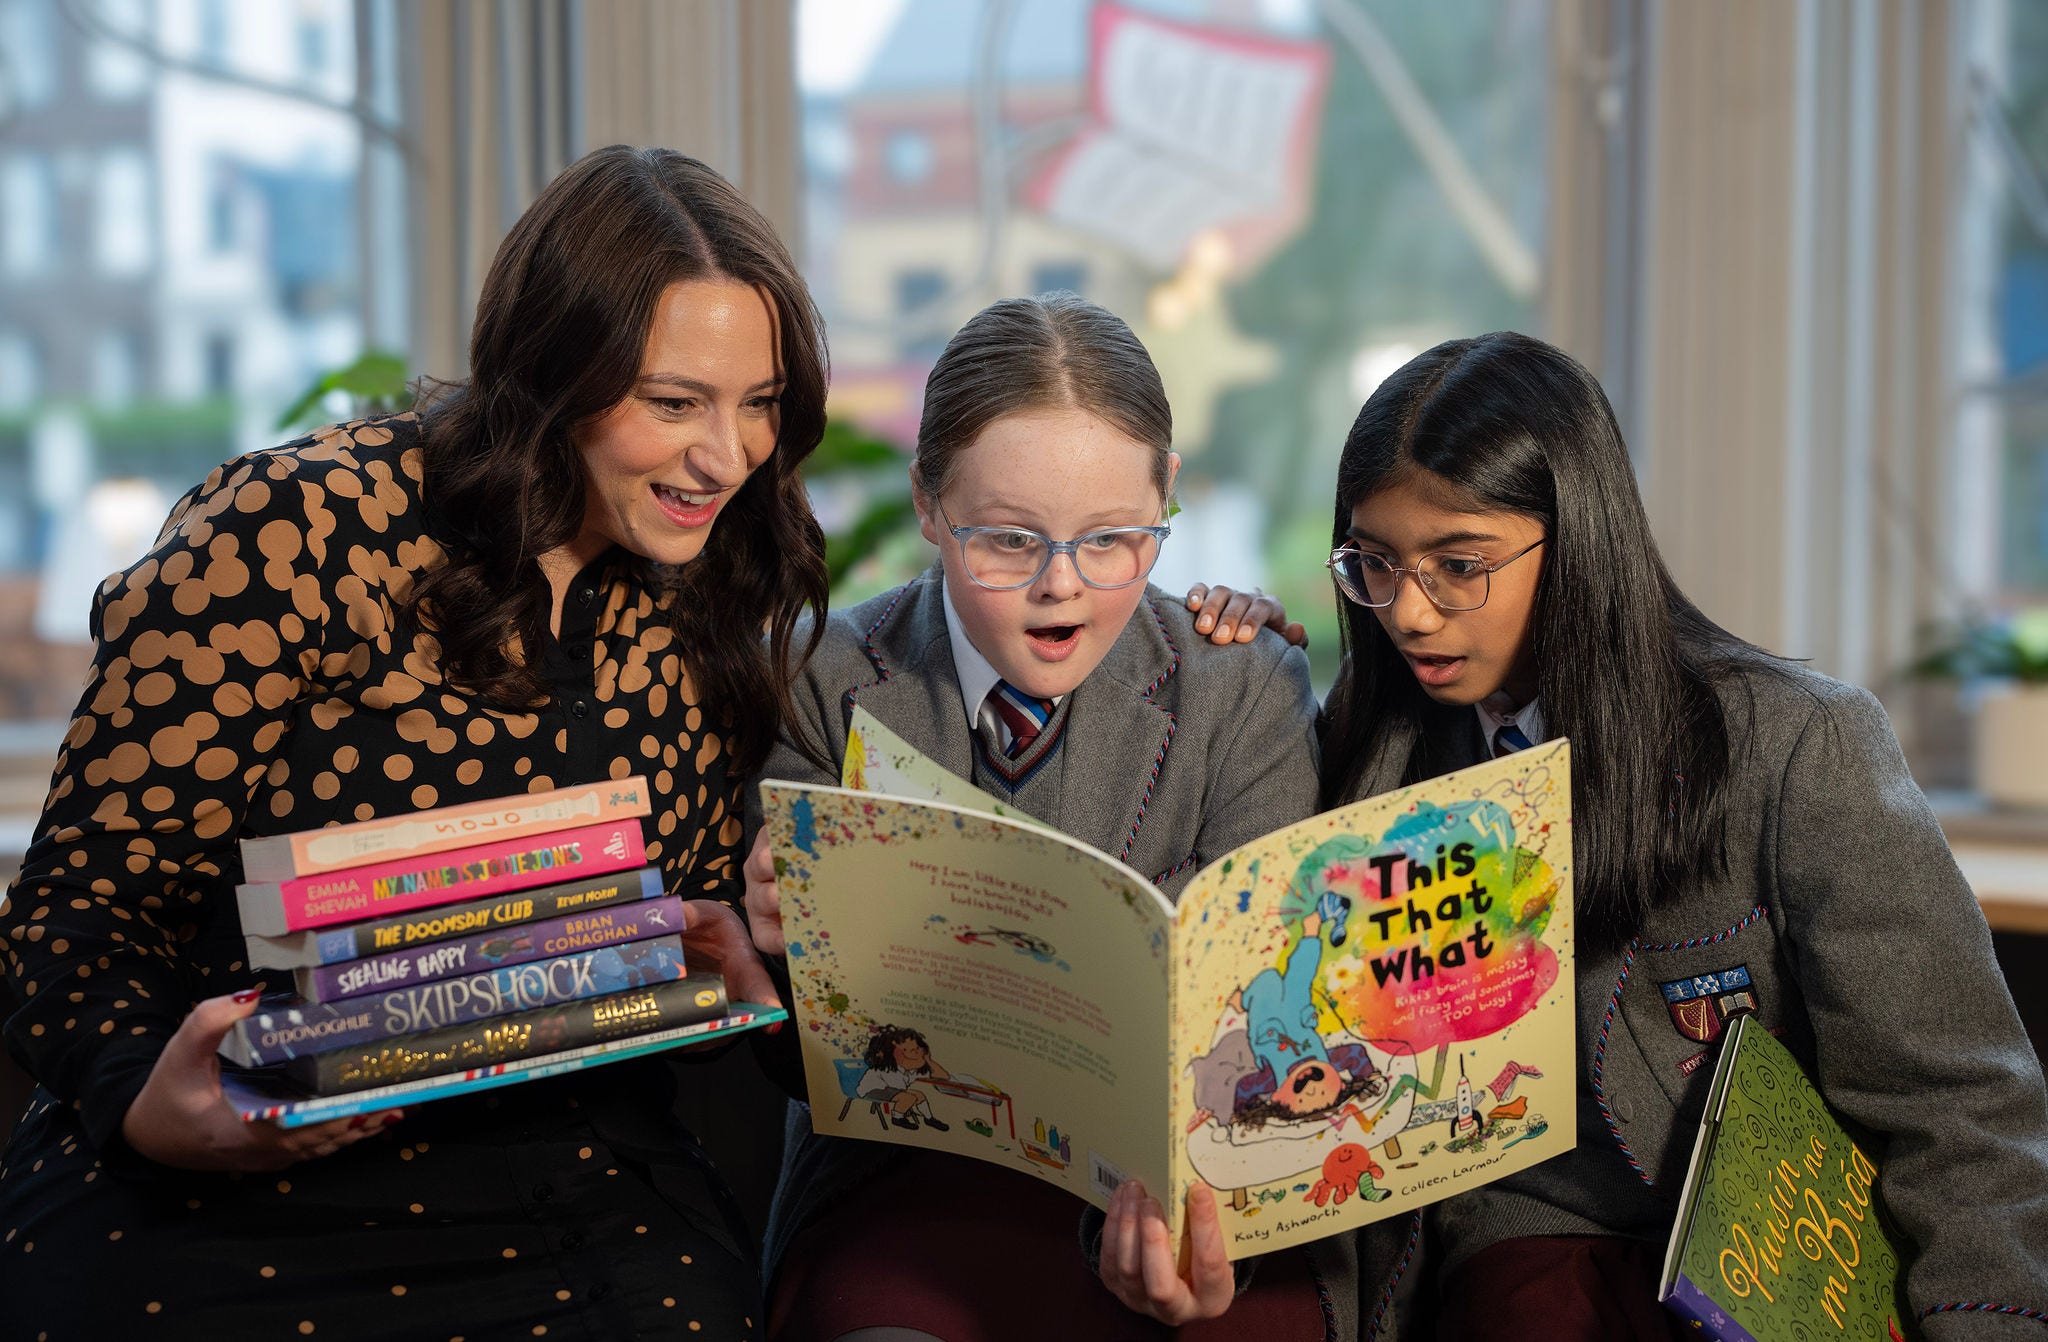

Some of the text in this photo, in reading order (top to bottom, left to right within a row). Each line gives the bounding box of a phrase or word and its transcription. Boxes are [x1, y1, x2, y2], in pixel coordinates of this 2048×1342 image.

[306, 879, 361, 900] EMMA
[373, 876, 400, 901] MY
[401, 866, 452, 895] NAME
[530, 842, 584, 872] JONES
[1369, 842, 1476, 899] This
[304, 895, 368, 917] SHEVAH
[373, 925, 402, 948] THE
[404, 909, 490, 942] DOOMSDAY
[493, 899, 533, 923] CLUB
[556, 890, 584, 909] KEVIN
[585, 886, 618, 903] MORAN
[565, 915, 614, 935] BRIAN
[1369, 879, 1493, 940] That
[544, 923, 639, 953] CONAGHAN
[1370, 921, 1494, 989] What
[337, 944, 467, 994] STEALING HAPPY
[1395, 956, 1528, 1008] Kiki's brain is messy
[383, 953, 598, 1035] SKIPSHOCK
[592, 991, 658, 1022] EILISH
[1393, 967, 1536, 1026] and fizzy and sometimes
[1478, 990, 1513, 1012] busy!
[1401, 1151, 1508, 1197] Colleen Larmour
[1802, 1134, 1827, 1180] na
[1234, 1206, 1341, 1243] Katy Ashworth
